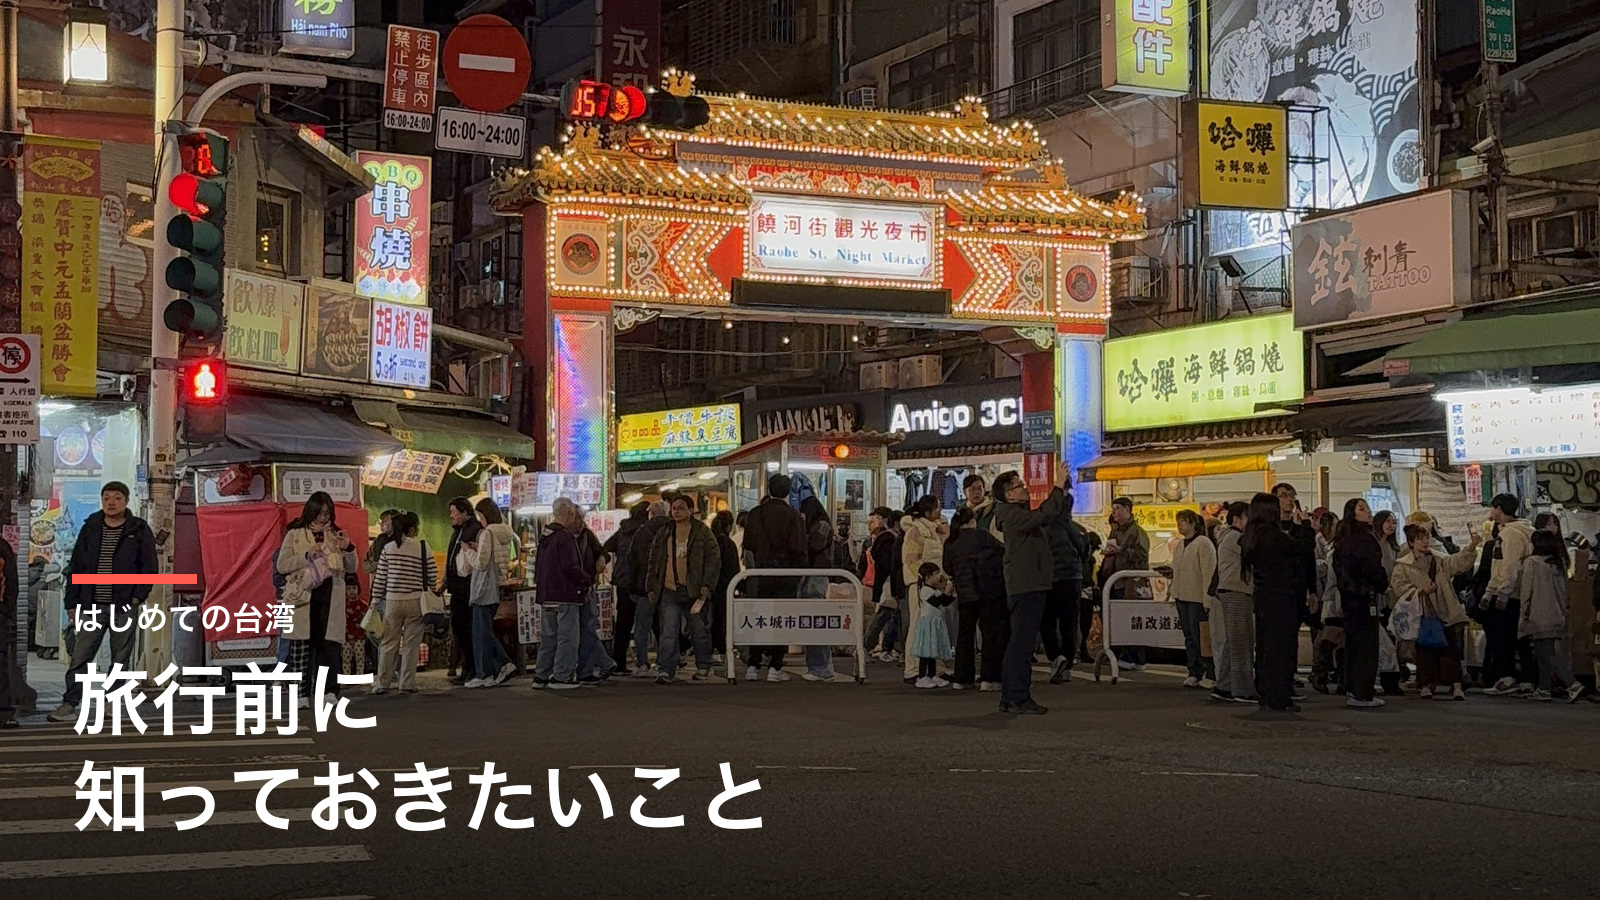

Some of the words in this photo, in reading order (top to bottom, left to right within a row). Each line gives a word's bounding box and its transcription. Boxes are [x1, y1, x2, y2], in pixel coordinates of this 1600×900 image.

[391, 30, 411, 105] 禁止停車
[413, 33, 432, 108] 徒步區內
[386, 112, 432, 131] 16:00-24:00
[442, 119, 520, 147] 16:00~24:00
[367, 164, 418, 185] BBQ
[1214, 159, 1271, 175] 海鮮鍋燒
[370, 181, 412, 271] 串燒
[756, 212, 928, 243] 饒河街觀光夜市
[758, 244, 799, 258] Raohe
[809, 247, 827, 260] St.
[837, 249, 872, 265] Night
[882, 252, 927, 266] Market
[1362, 240, 1416, 277] 刺青
[1367, 265, 1431, 292] TATTOO
[229, 324, 278, 363] 飲料吧
[375, 307, 429, 352] 胡椒餅
[375, 351, 398, 381] 5.9折
[400, 357, 416, 368] second
[889, 400, 970, 436] Amigo
[980, 397, 1023, 427] 3C
[12, 430, 27, 438] 110
